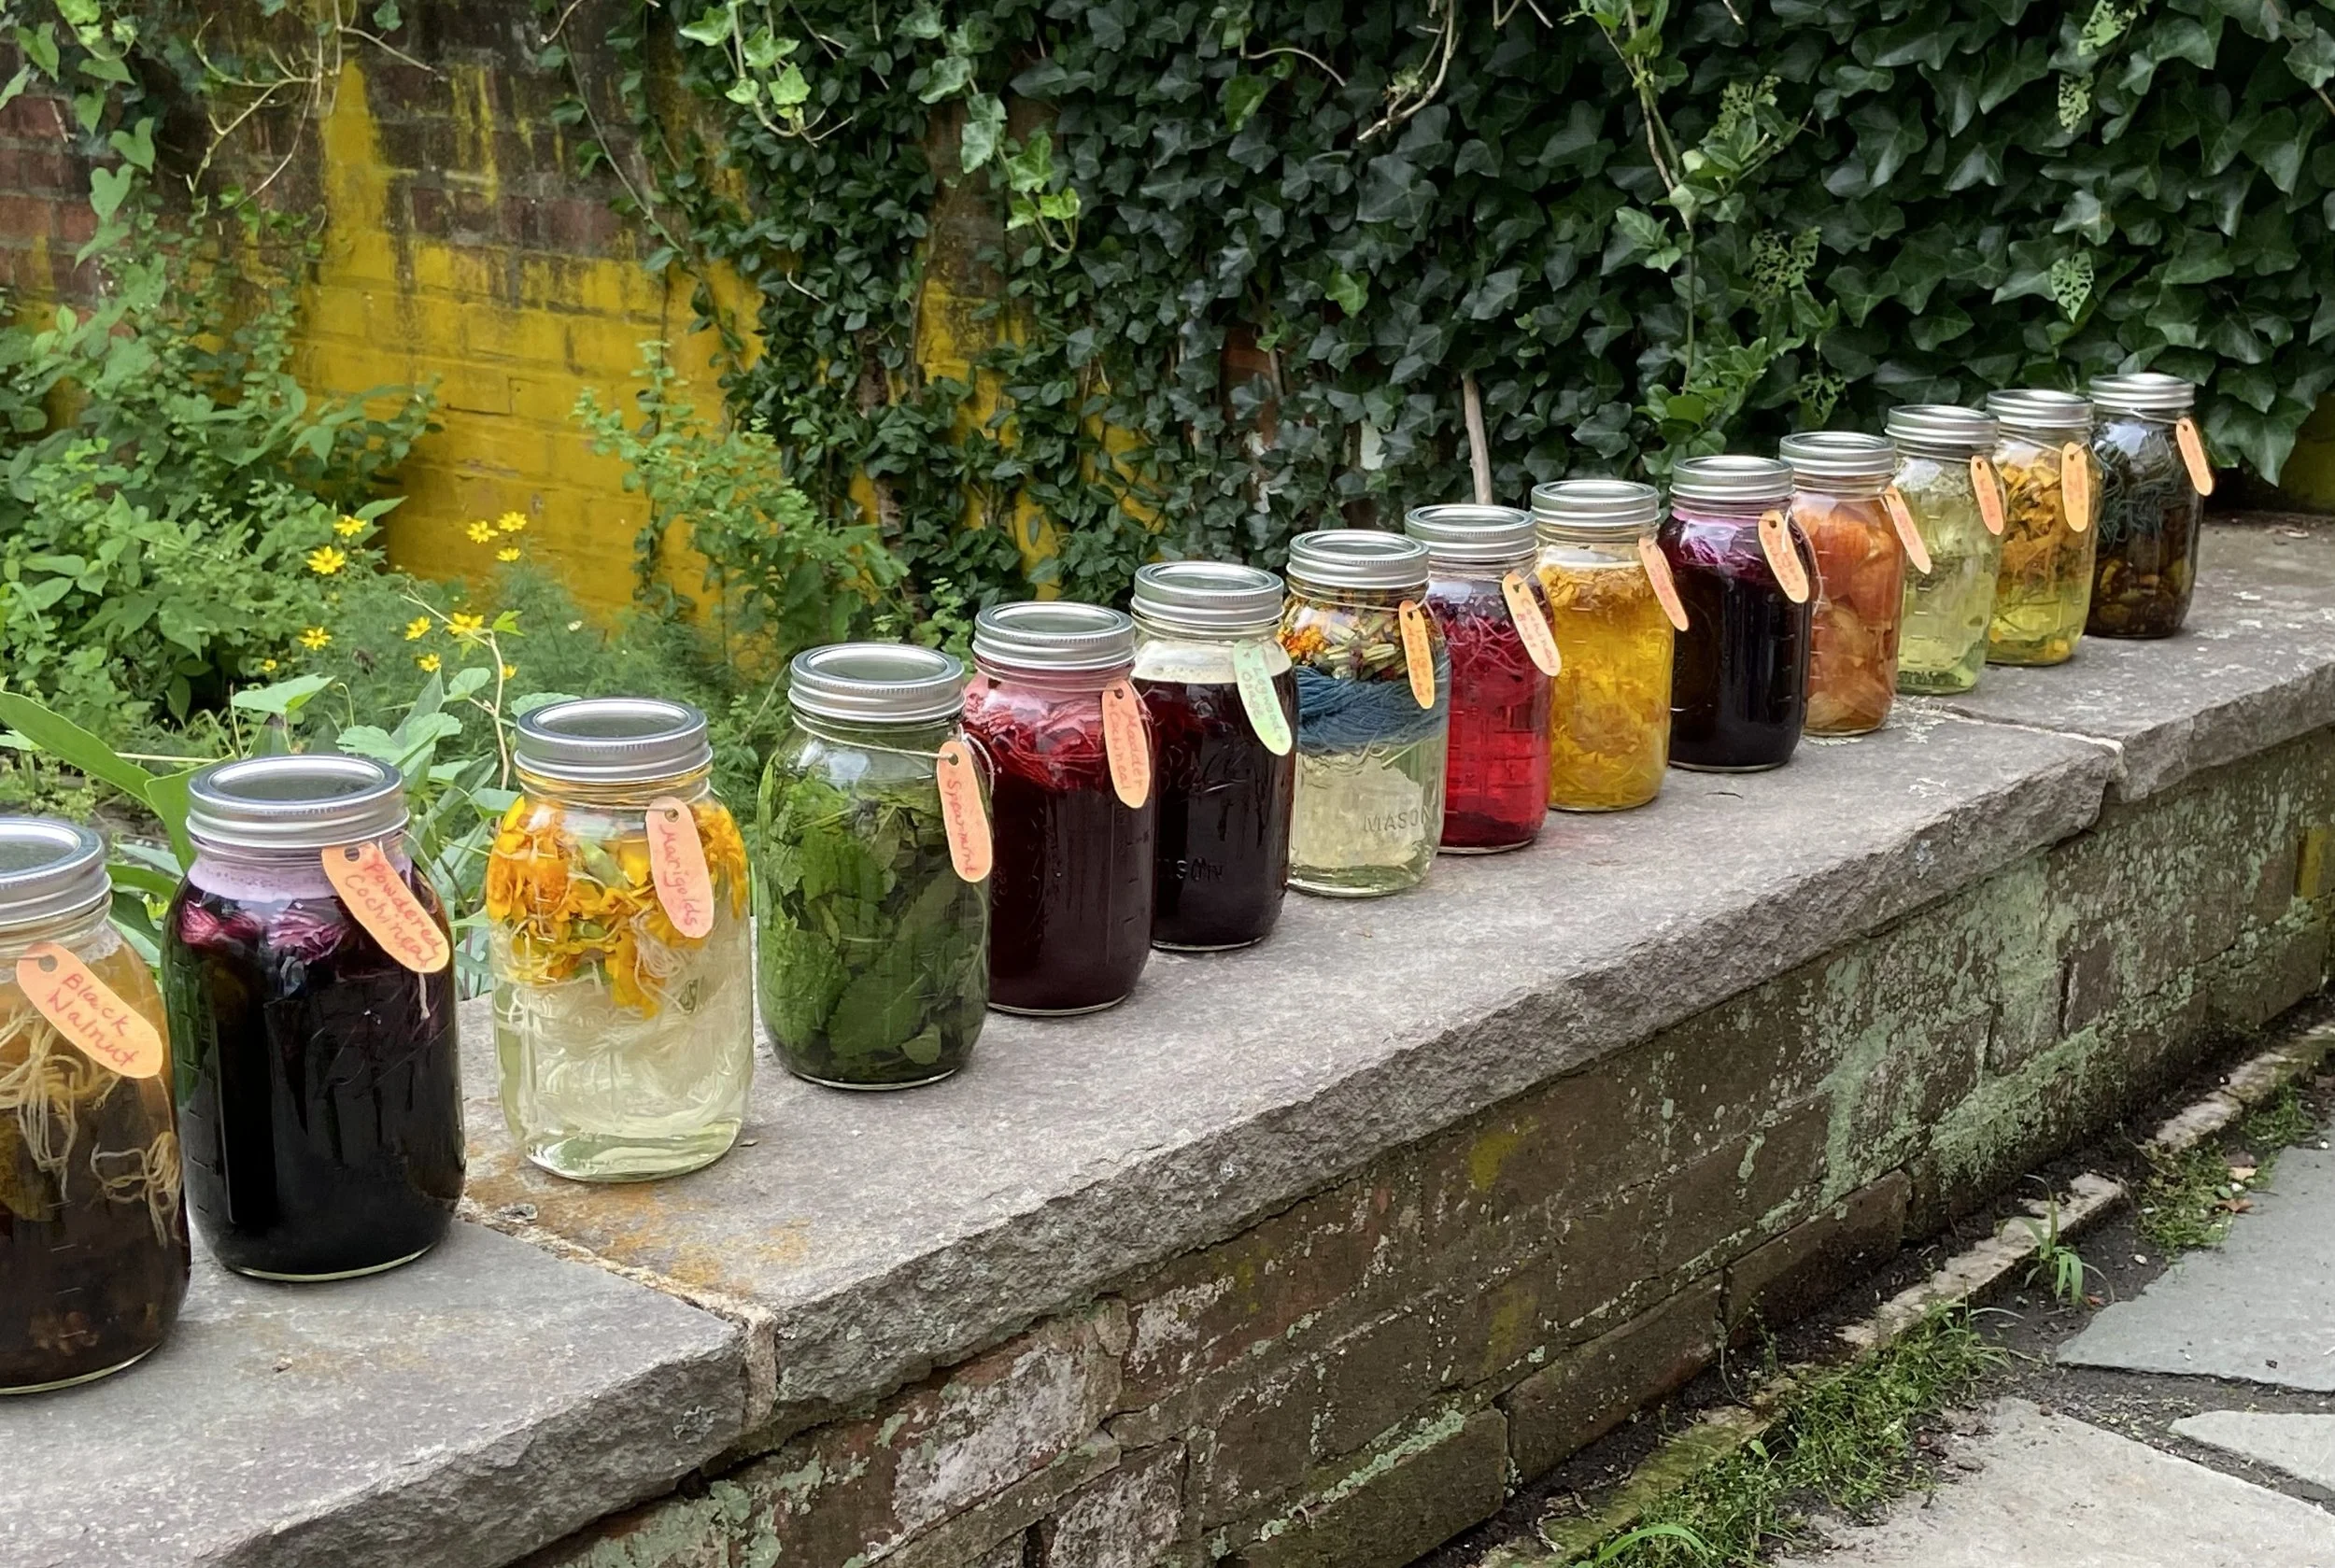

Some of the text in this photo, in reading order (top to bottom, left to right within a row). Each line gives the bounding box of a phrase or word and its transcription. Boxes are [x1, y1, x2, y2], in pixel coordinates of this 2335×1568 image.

[1110, 711, 1131, 791] Cochineal
[1120, 709, 1143, 789] Madder
[945, 777, 978, 876] Spearmint
[1363, 806, 1432, 832] MASON
[658, 823, 701, 927] Marigolds
[46, 987, 141, 1067] Walnut
[61, 972, 132, 1036] Black
